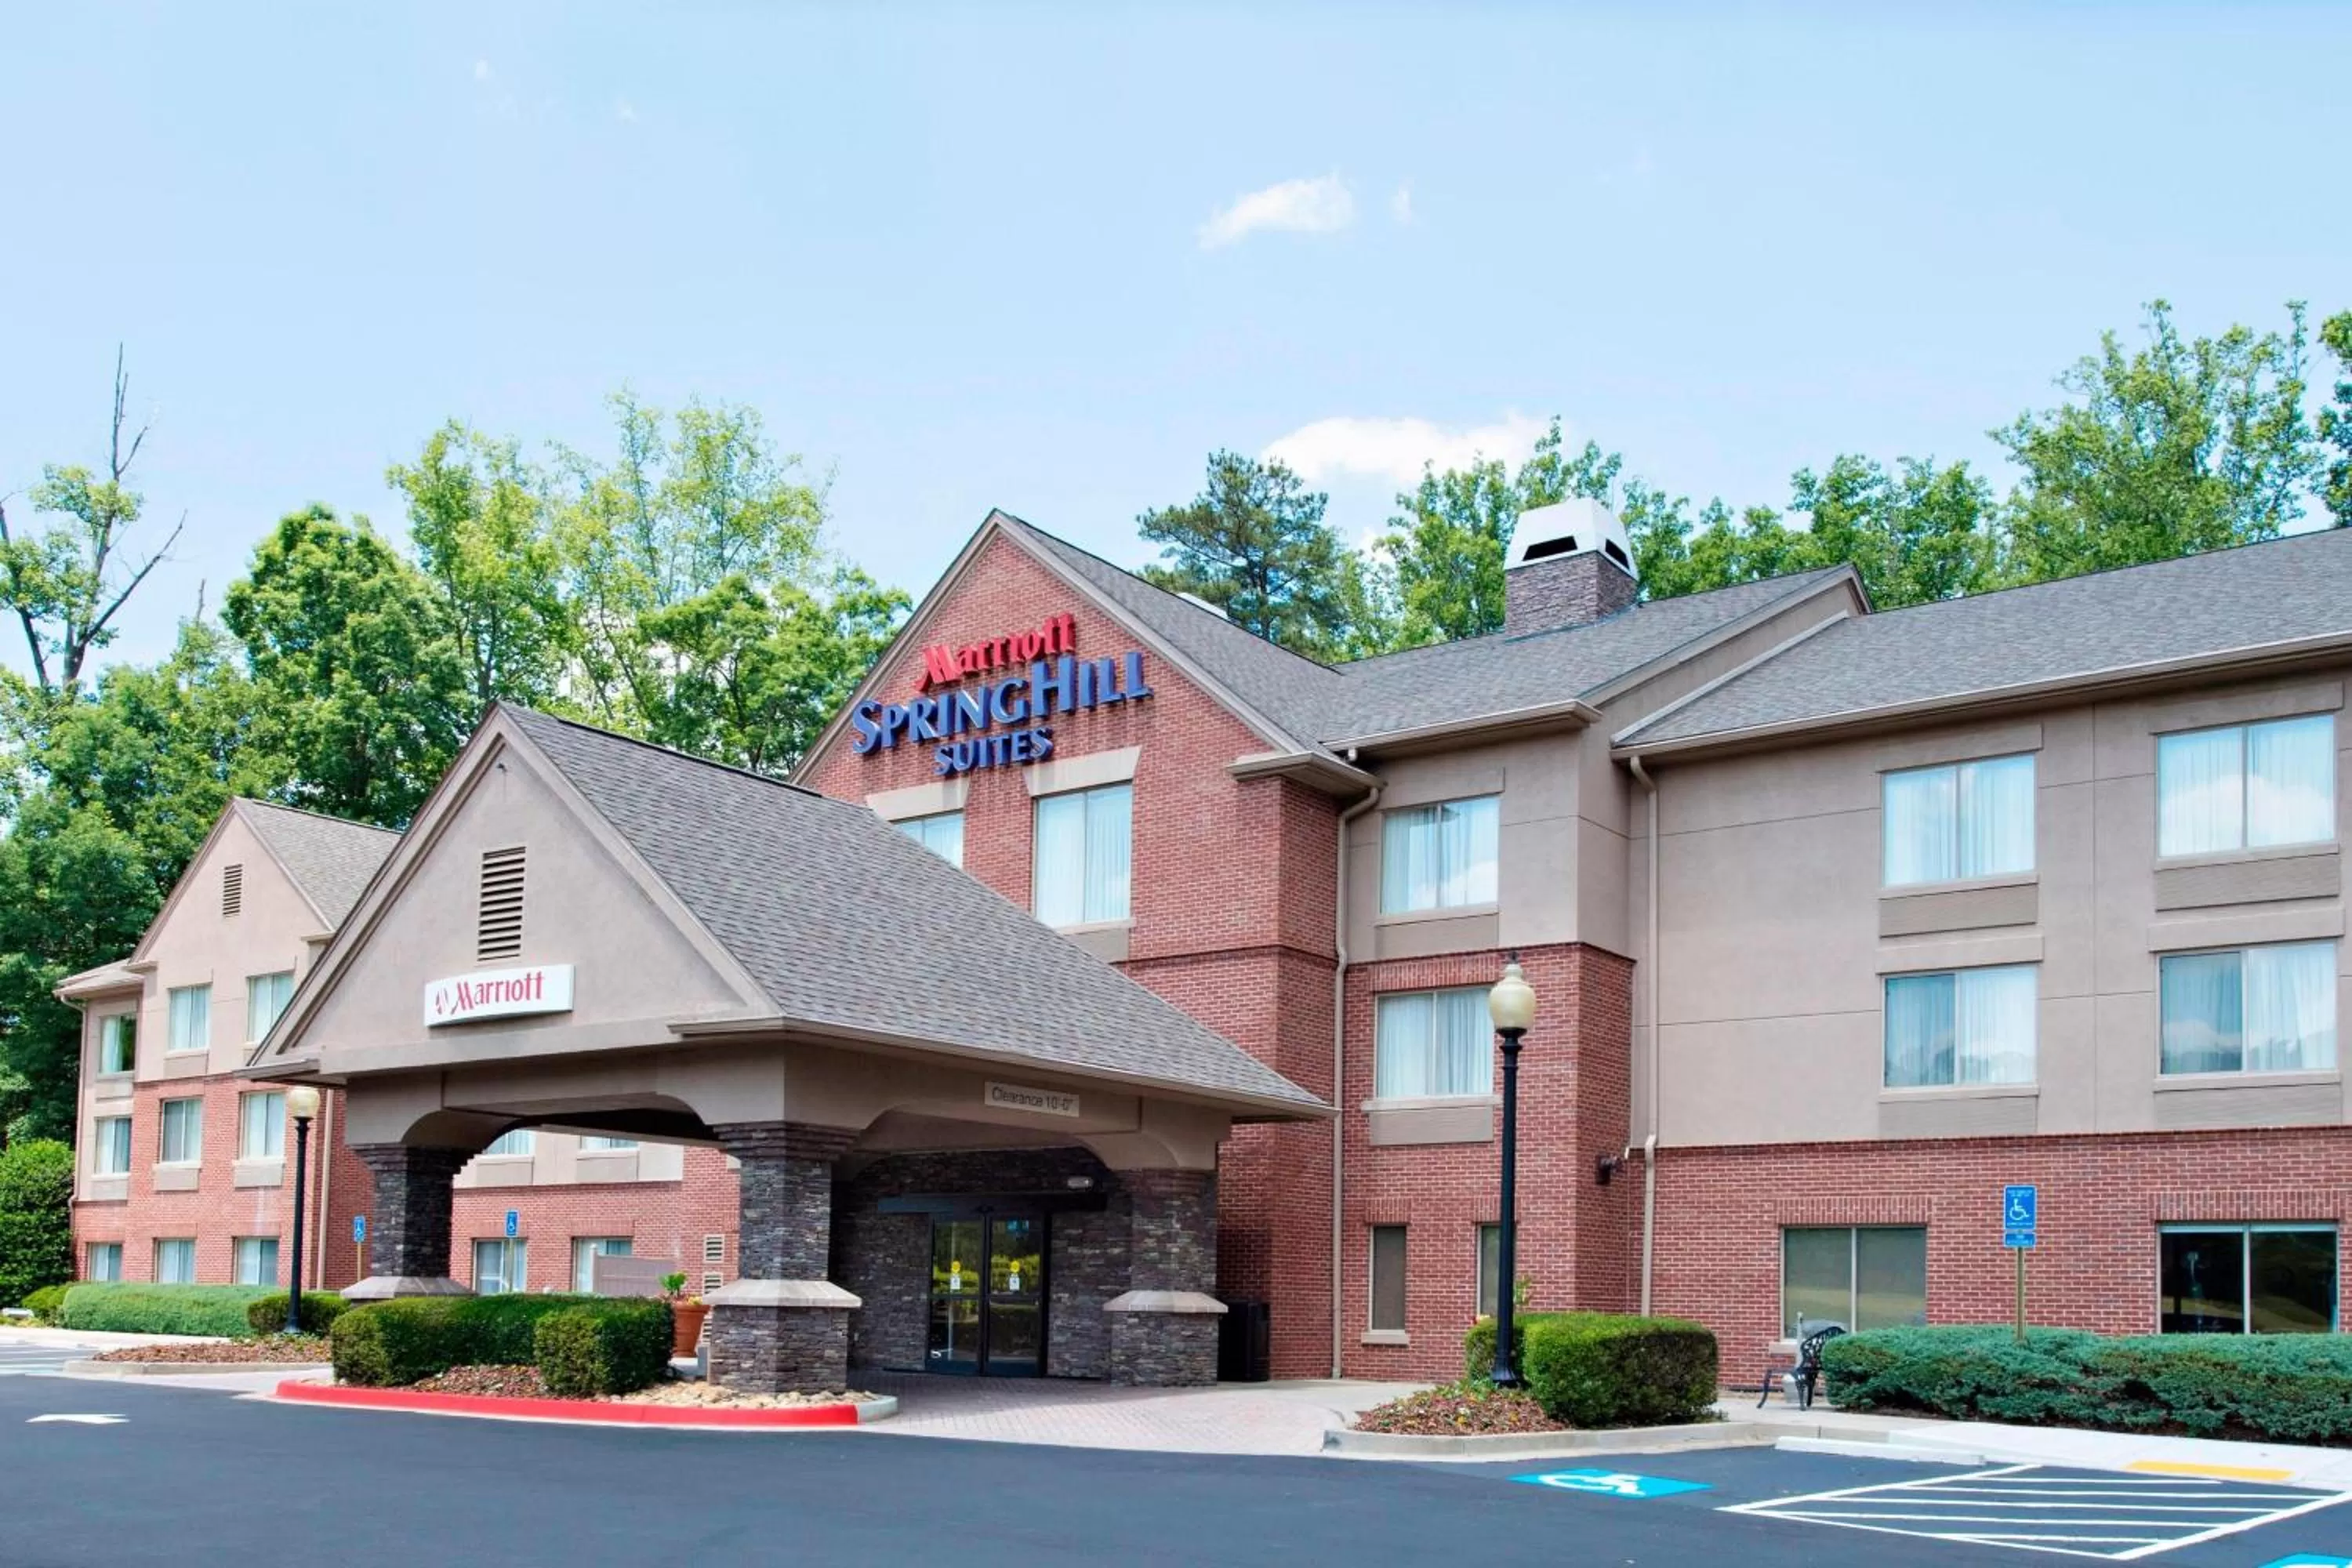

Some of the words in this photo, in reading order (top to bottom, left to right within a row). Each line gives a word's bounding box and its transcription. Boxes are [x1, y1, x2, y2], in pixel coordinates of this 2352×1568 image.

[916, 613, 1076, 691] Marriott
[934, 726, 1054, 775] SUITES
[450, 971, 544, 1014] Marriott
